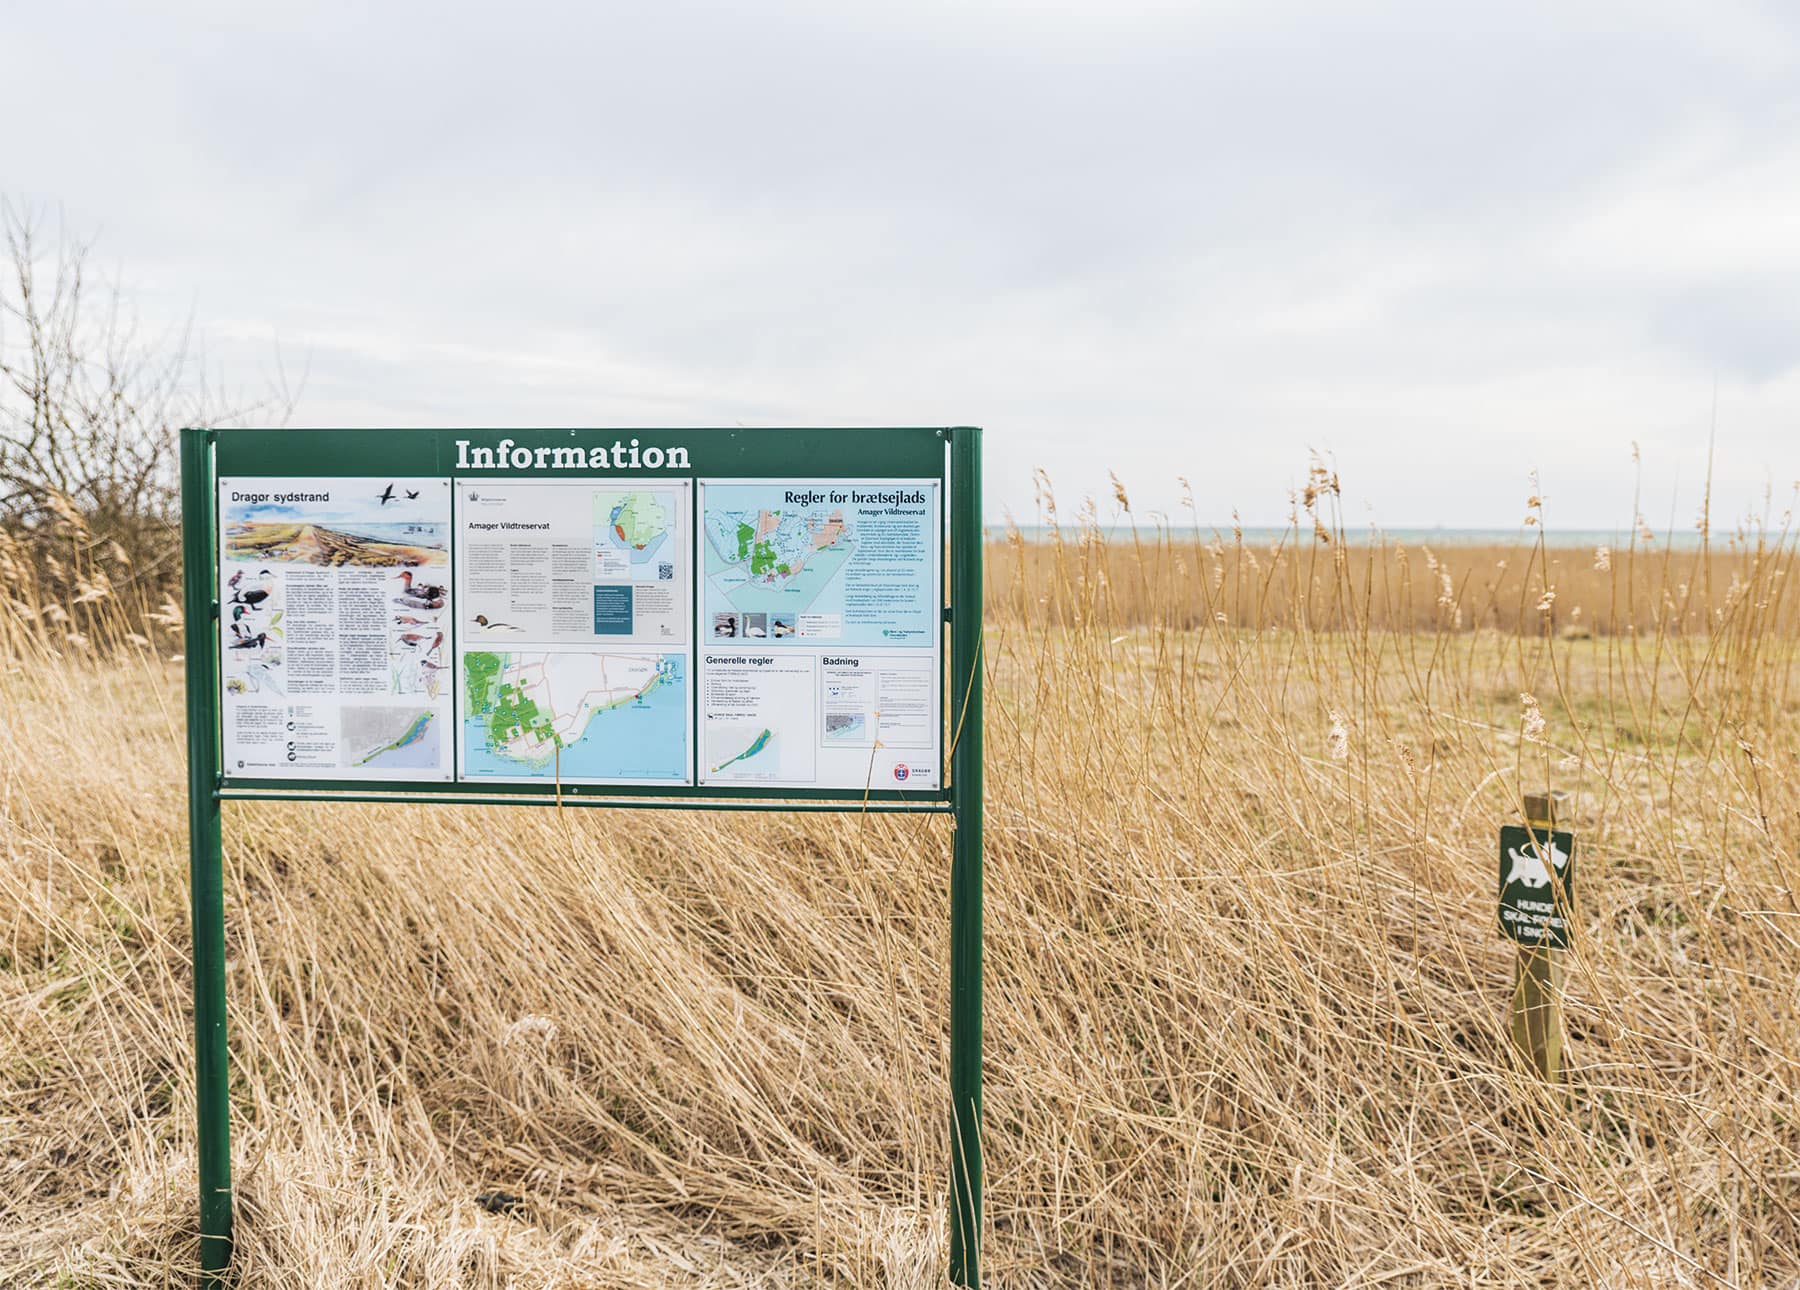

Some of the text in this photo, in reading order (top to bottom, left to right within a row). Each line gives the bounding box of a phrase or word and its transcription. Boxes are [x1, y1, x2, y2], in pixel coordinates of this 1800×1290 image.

[456, 438, 691, 469] Information
[274, 491, 330, 504] sydstrand
[785, 490, 926, 507] Regler for brætsejlads
[857, 508, 926, 517] Amager Vildtreservat
[468, 522, 550, 531] Amager Vildtreservat
[705, 655, 774, 666] Generelle regler
[822, 657, 859, 667] Badning
